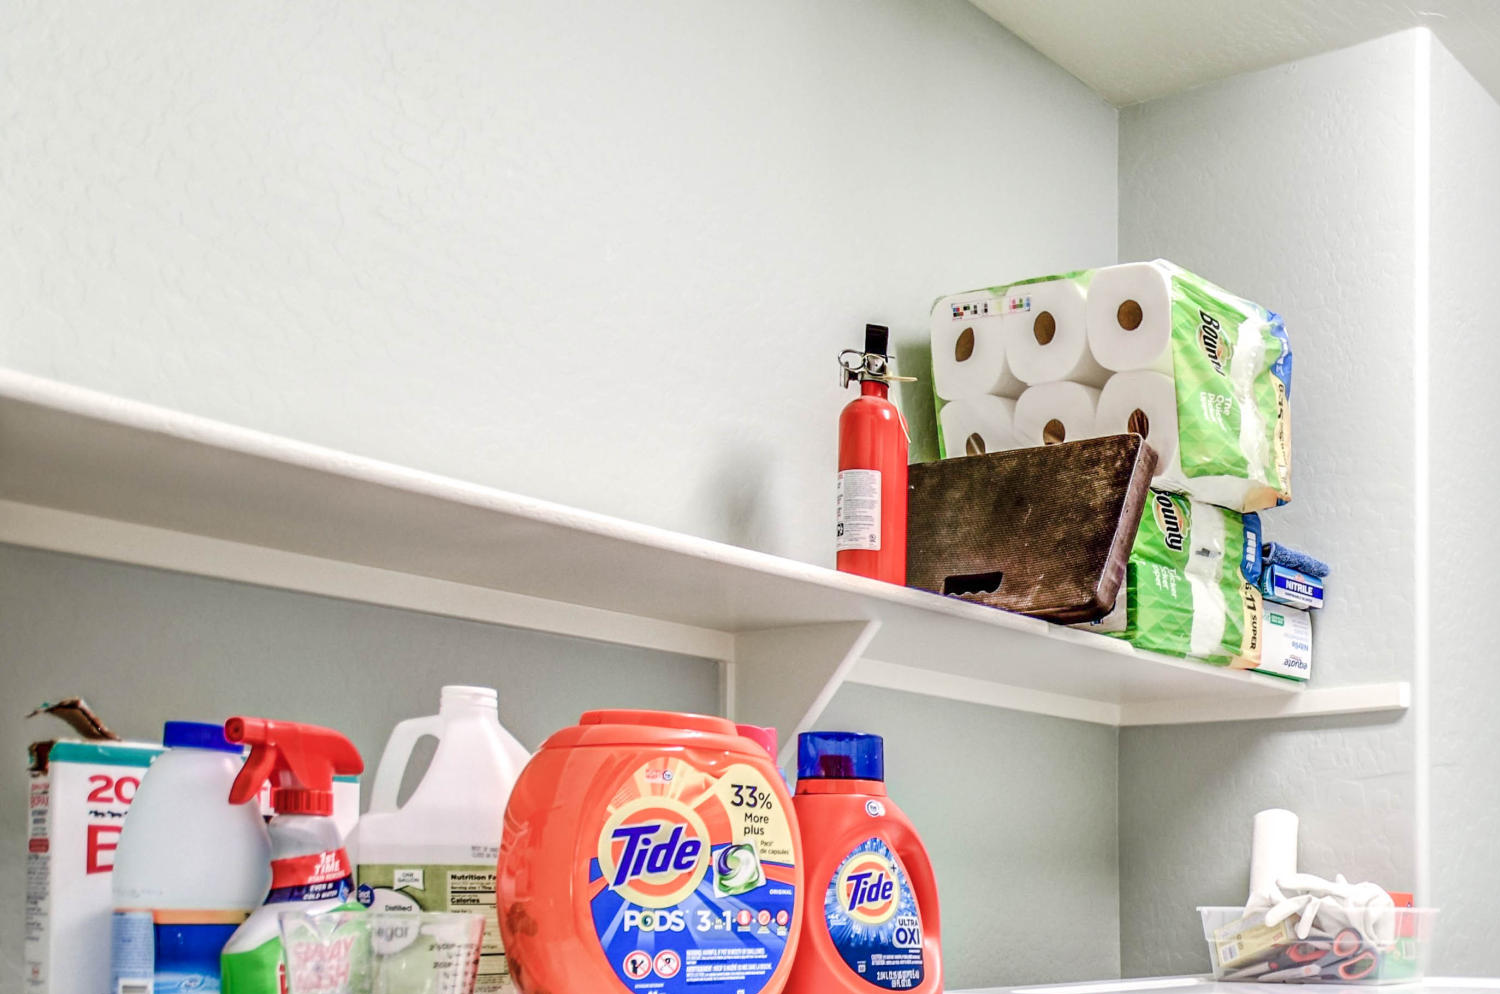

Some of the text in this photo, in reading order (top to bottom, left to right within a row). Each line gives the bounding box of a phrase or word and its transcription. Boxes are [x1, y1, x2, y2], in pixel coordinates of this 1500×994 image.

[1285, 579, 1313, 595] NITRILE
[1249, 615, 1258, 650] SUPER
[731, 784, 773, 810] 33%
[744, 812, 769, 824] More
[744, 824, 765, 836] plus
[611, 824, 702, 888] Tide
[314, 860, 341, 875] TIME
[451, 874, 486, 882] Nutrition
[769, 888, 792, 896] ORIGINAL
[846, 872, 894, 912] Tide
[623, 909, 686, 932] PODS
[898, 918, 919, 927] ULTRA
[896, 927, 920, 945] OXI
